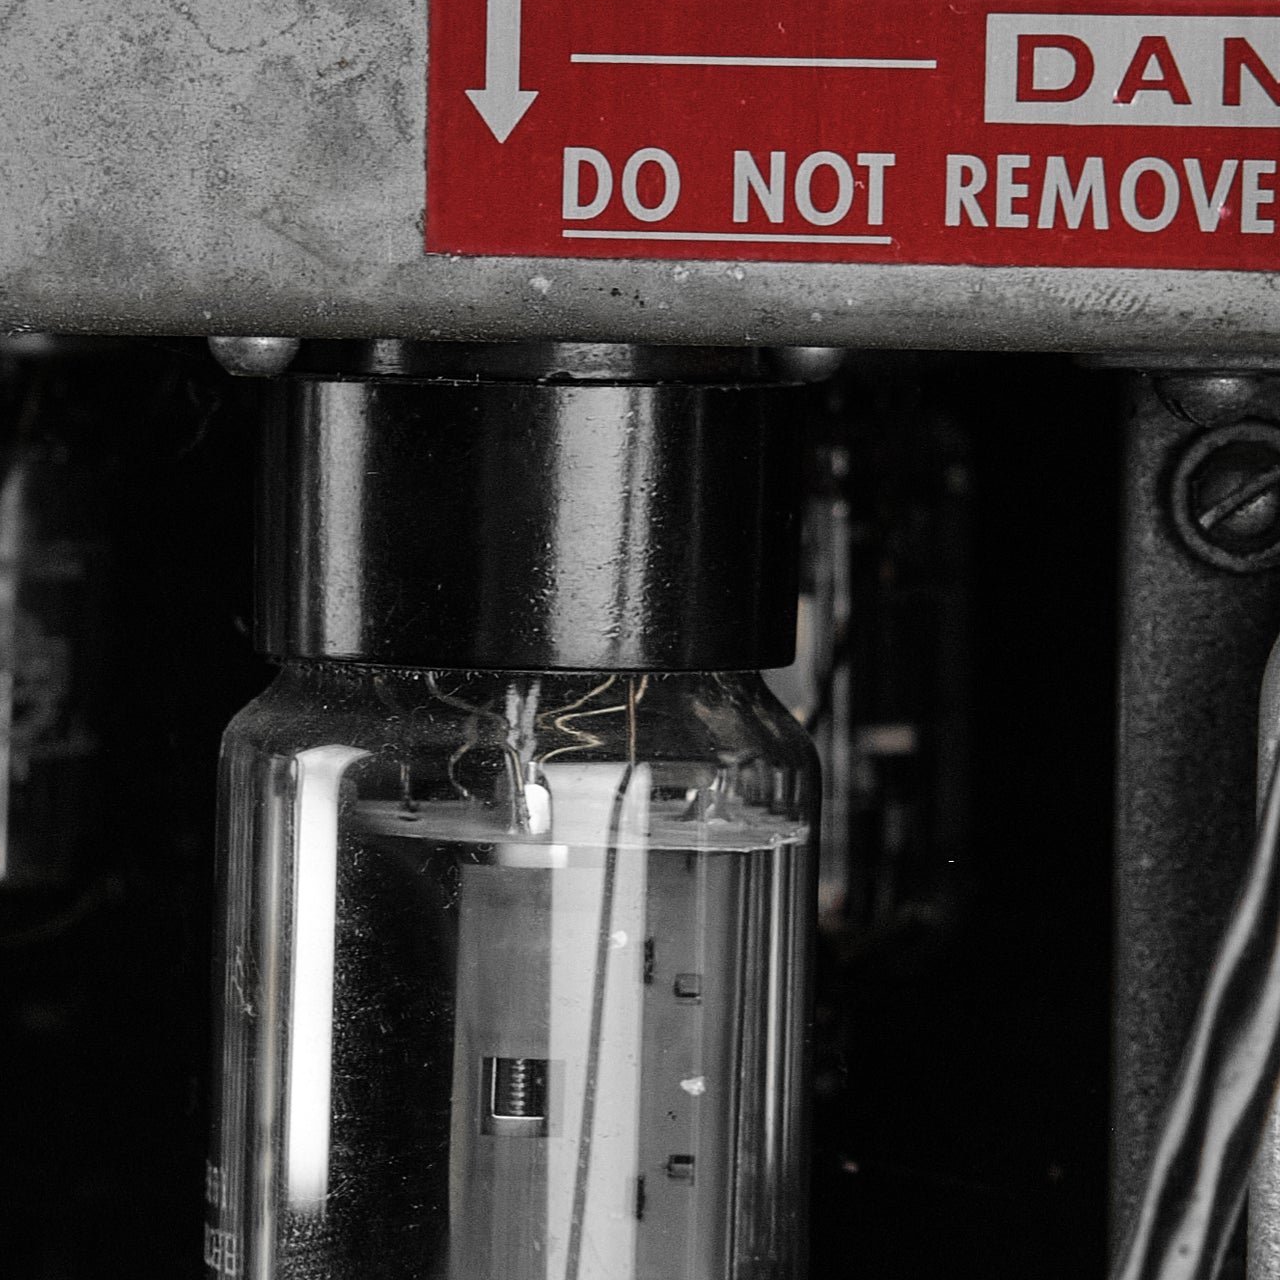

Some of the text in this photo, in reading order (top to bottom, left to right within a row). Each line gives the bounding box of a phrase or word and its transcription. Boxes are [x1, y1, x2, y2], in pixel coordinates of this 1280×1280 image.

[562, 146, 681, 222] DO
[732, 150, 896, 226] NOT
[945, 153, 1278, 235] REMOVE
